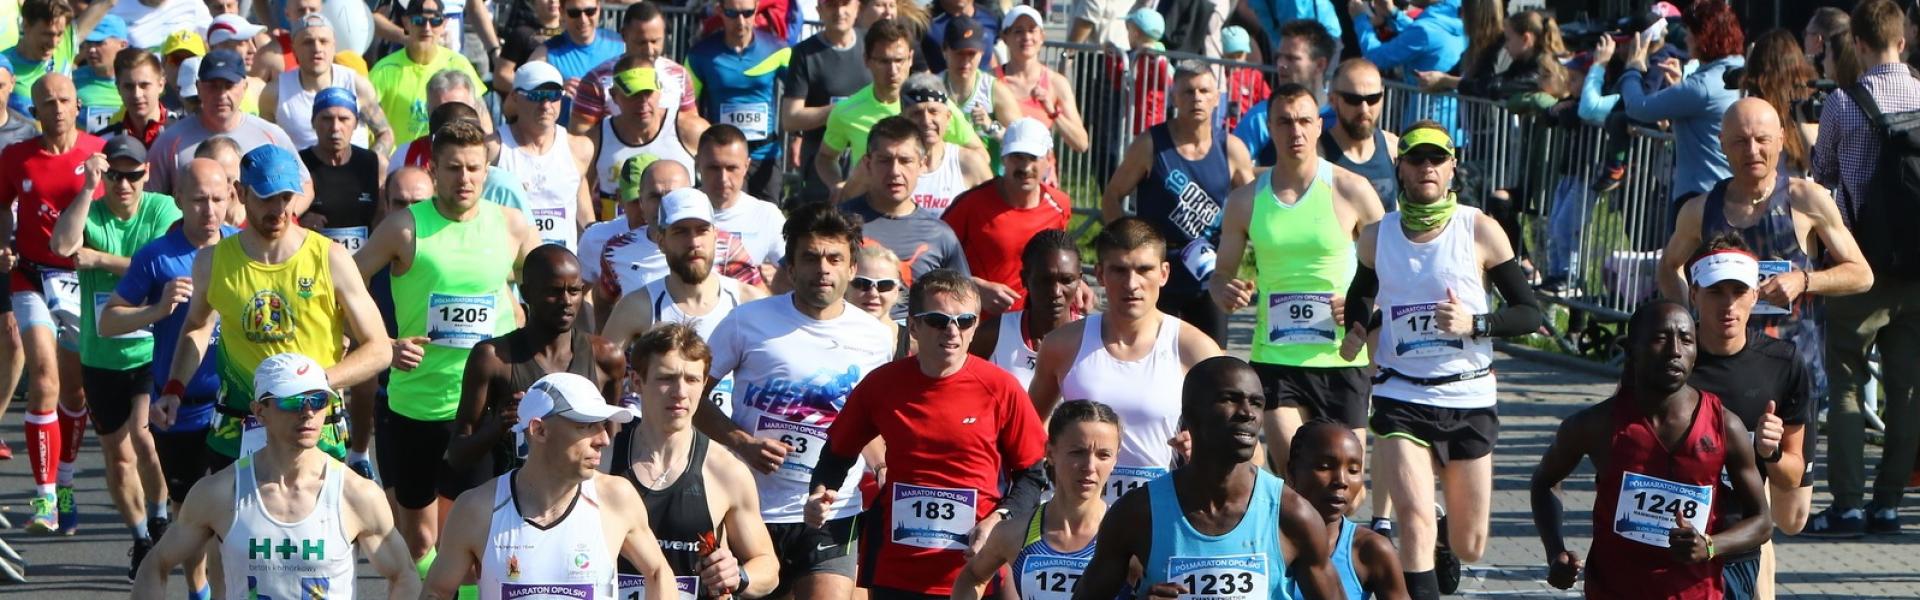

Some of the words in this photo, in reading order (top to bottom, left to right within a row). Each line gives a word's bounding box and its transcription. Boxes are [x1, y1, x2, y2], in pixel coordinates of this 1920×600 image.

[728, 113, 761, 123] 1058
[439, 306, 488, 323] 1205
[1289, 304, 1314, 319] 96
[1396, 304, 1427, 316] MARATON
[1407, 315, 1438, 332] 17
[764, 421, 799, 432] MARATON
[901, 490, 937, 498] MARATON
[937, 491, 968, 502] OPOLSKI
[911, 501, 955, 520] 183
[1633, 491, 1698, 519] 1248
[249, 538, 325, 560] H+H
[1029, 559, 1077, 569] PÓŁMARATON
[1175, 559, 1228, 572] PÓŁMARATON
[1183, 572, 1254, 595] 1233
[509, 586, 551, 598] MARATON
[551, 586, 588, 598] OPOLSKI
